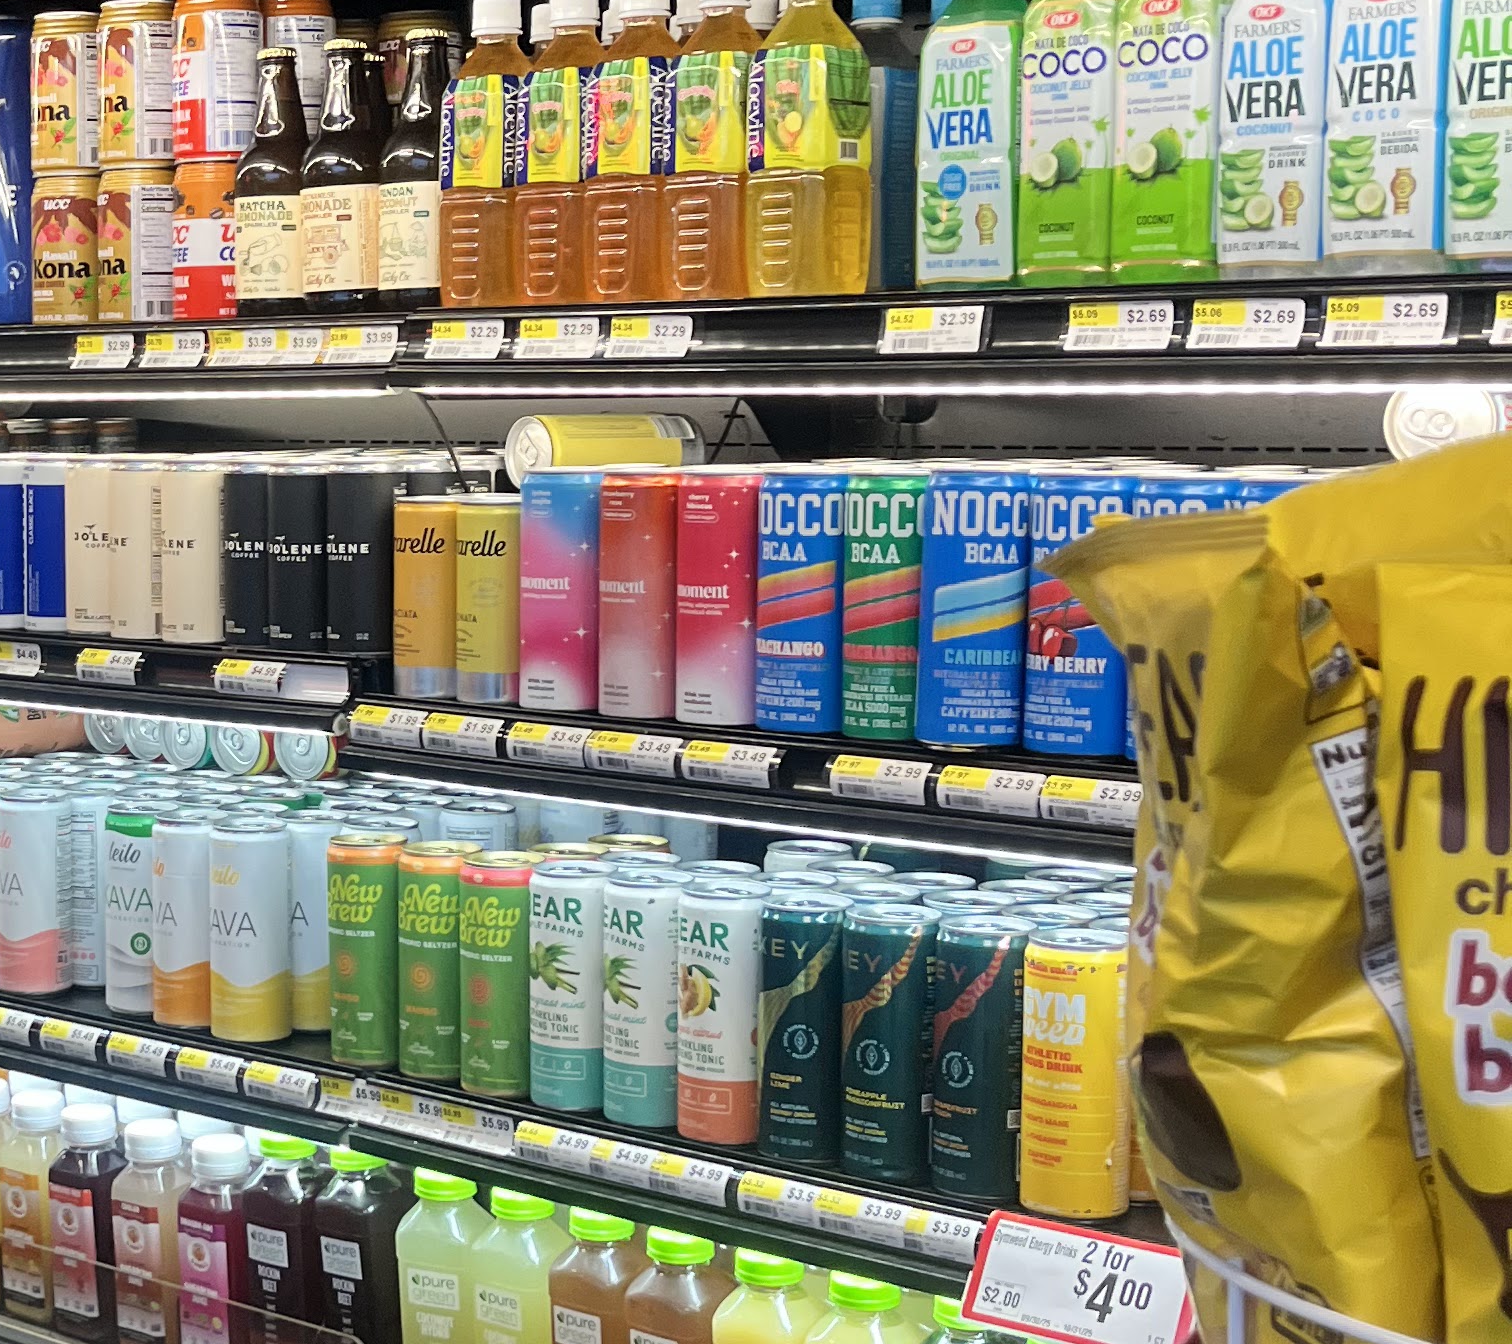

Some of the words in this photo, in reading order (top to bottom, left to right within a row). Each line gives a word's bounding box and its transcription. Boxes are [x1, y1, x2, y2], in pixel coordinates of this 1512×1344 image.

[1250, 5, 1284, 20] OKF
[1348, 1, 1416, 19] FARMER'S
[1235, 20, 1301, 37] FARMER'S
[1340, 18, 1417, 62] ALOE
[1119, 35, 1208, 67] COCO
[1228, 37, 1303, 77] ALOE
[1022, 47, 1106, 79] COCO
[931, 69, 992, 107] ALOE
[1338, 62, 1416, 106] VERA
[1227, 80, 1305, 122] VERA
[749, 65, 763, 158] Aloevine
[926, 110, 992, 148] VERA
[1237, 122, 1292, 136] COCONUT
[1268, 158, 1306, 169] DRINK
[239, 200, 285, 212] MATCHA
[34, 260, 90, 279] Kona
[1330, 303, 1359, 313] $5.09
[1393, 302, 1438, 318] $2.69
[940, 312, 976, 327] $2.39
[1127, 309, 1166, 325] $2.69
[1253, 309, 1295, 325] $2.69
[366, 330, 392, 343] $3.99
[470, 326, 498, 337] $2.29
[564, 324, 593, 336] $2.29
[654, 324, 685, 337] $2.29
[178, 337, 201, 348] $2.99
[248, 336, 272, 348] $3.99
[763, 543, 807, 561] BCAA
[851, 544, 900, 563] BCAA
[965, 543, 1019, 563] BCAA
[1055, 658, 1106, 674] BERRY
[638, 742, 670, 752] $3.49
[733, 750, 766, 761] $3.49
[884, 766, 922, 778] $2.99
[994, 778, 1033, 791] $2.99
[1100, 788, 1141, 802] $2.99
[464, 899, 520, 926] New
[482, 1117, 509, 1130] $5.99
[616, 1150, 647, 1165] $4.99
[689, 1165, 721, 1180] $4.99
[865, 1204, 901, 1220] $3.99
[933, 1220, 970, 1237] $3.99
[1029, 1235, 1054, 1254] Energy
[1055, 1240, 1077, 1258] Drinks
[1083, 1241, 1098, 1265] 2
[1103, 1244, 1134, 1272] for
[421, 1273, 456, 1289] pure
[982, 1286, 1020, 1309] $2.00
[562, 1313, 597, 1331] pure
